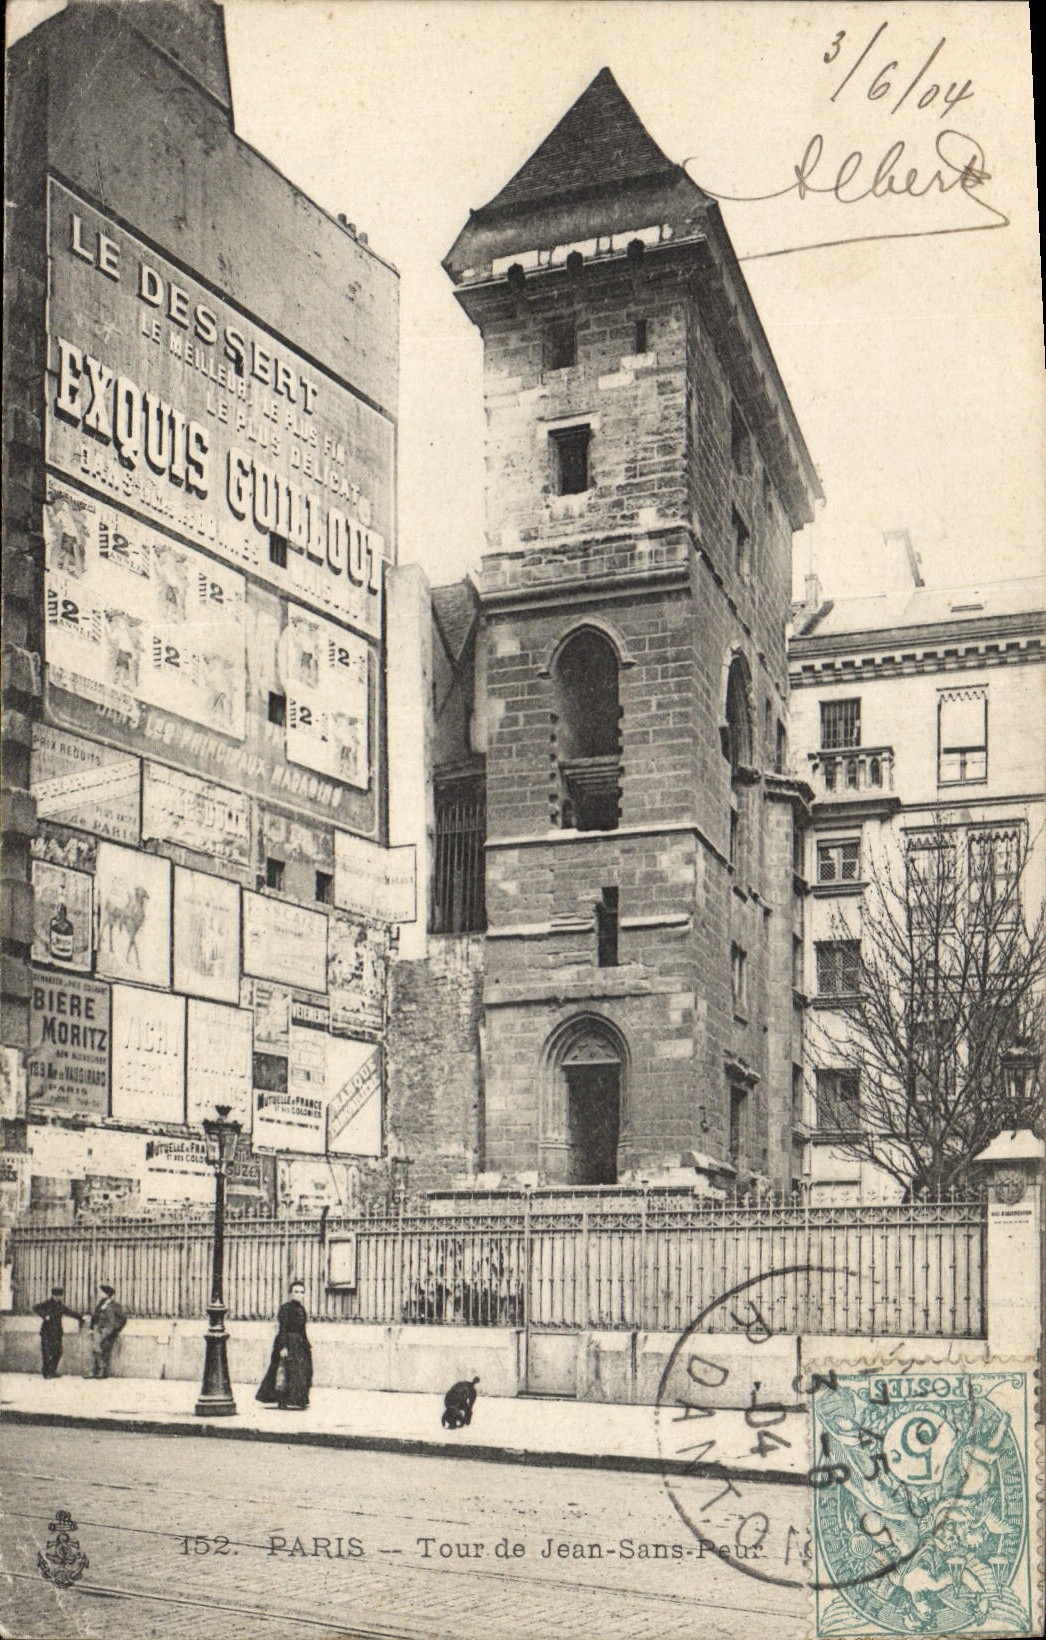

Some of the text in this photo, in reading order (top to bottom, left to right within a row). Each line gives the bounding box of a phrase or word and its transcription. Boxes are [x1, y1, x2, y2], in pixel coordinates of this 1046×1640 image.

[68, 213, 318, 416] LE DESSERT
[141, 311, 161, 345] LE
[205, 388, 228, 425] LE
[235, 406, 280, 458] PLUS
[54, 335, 210, 501] EXQUIS
[226, 447, 384, 597] GUILLOUT
[34, 985, 96, 1021] BIERE
[41, 1015, 107, 1052] MORITZ
[873, 1375, 967, 1400] POSTES
